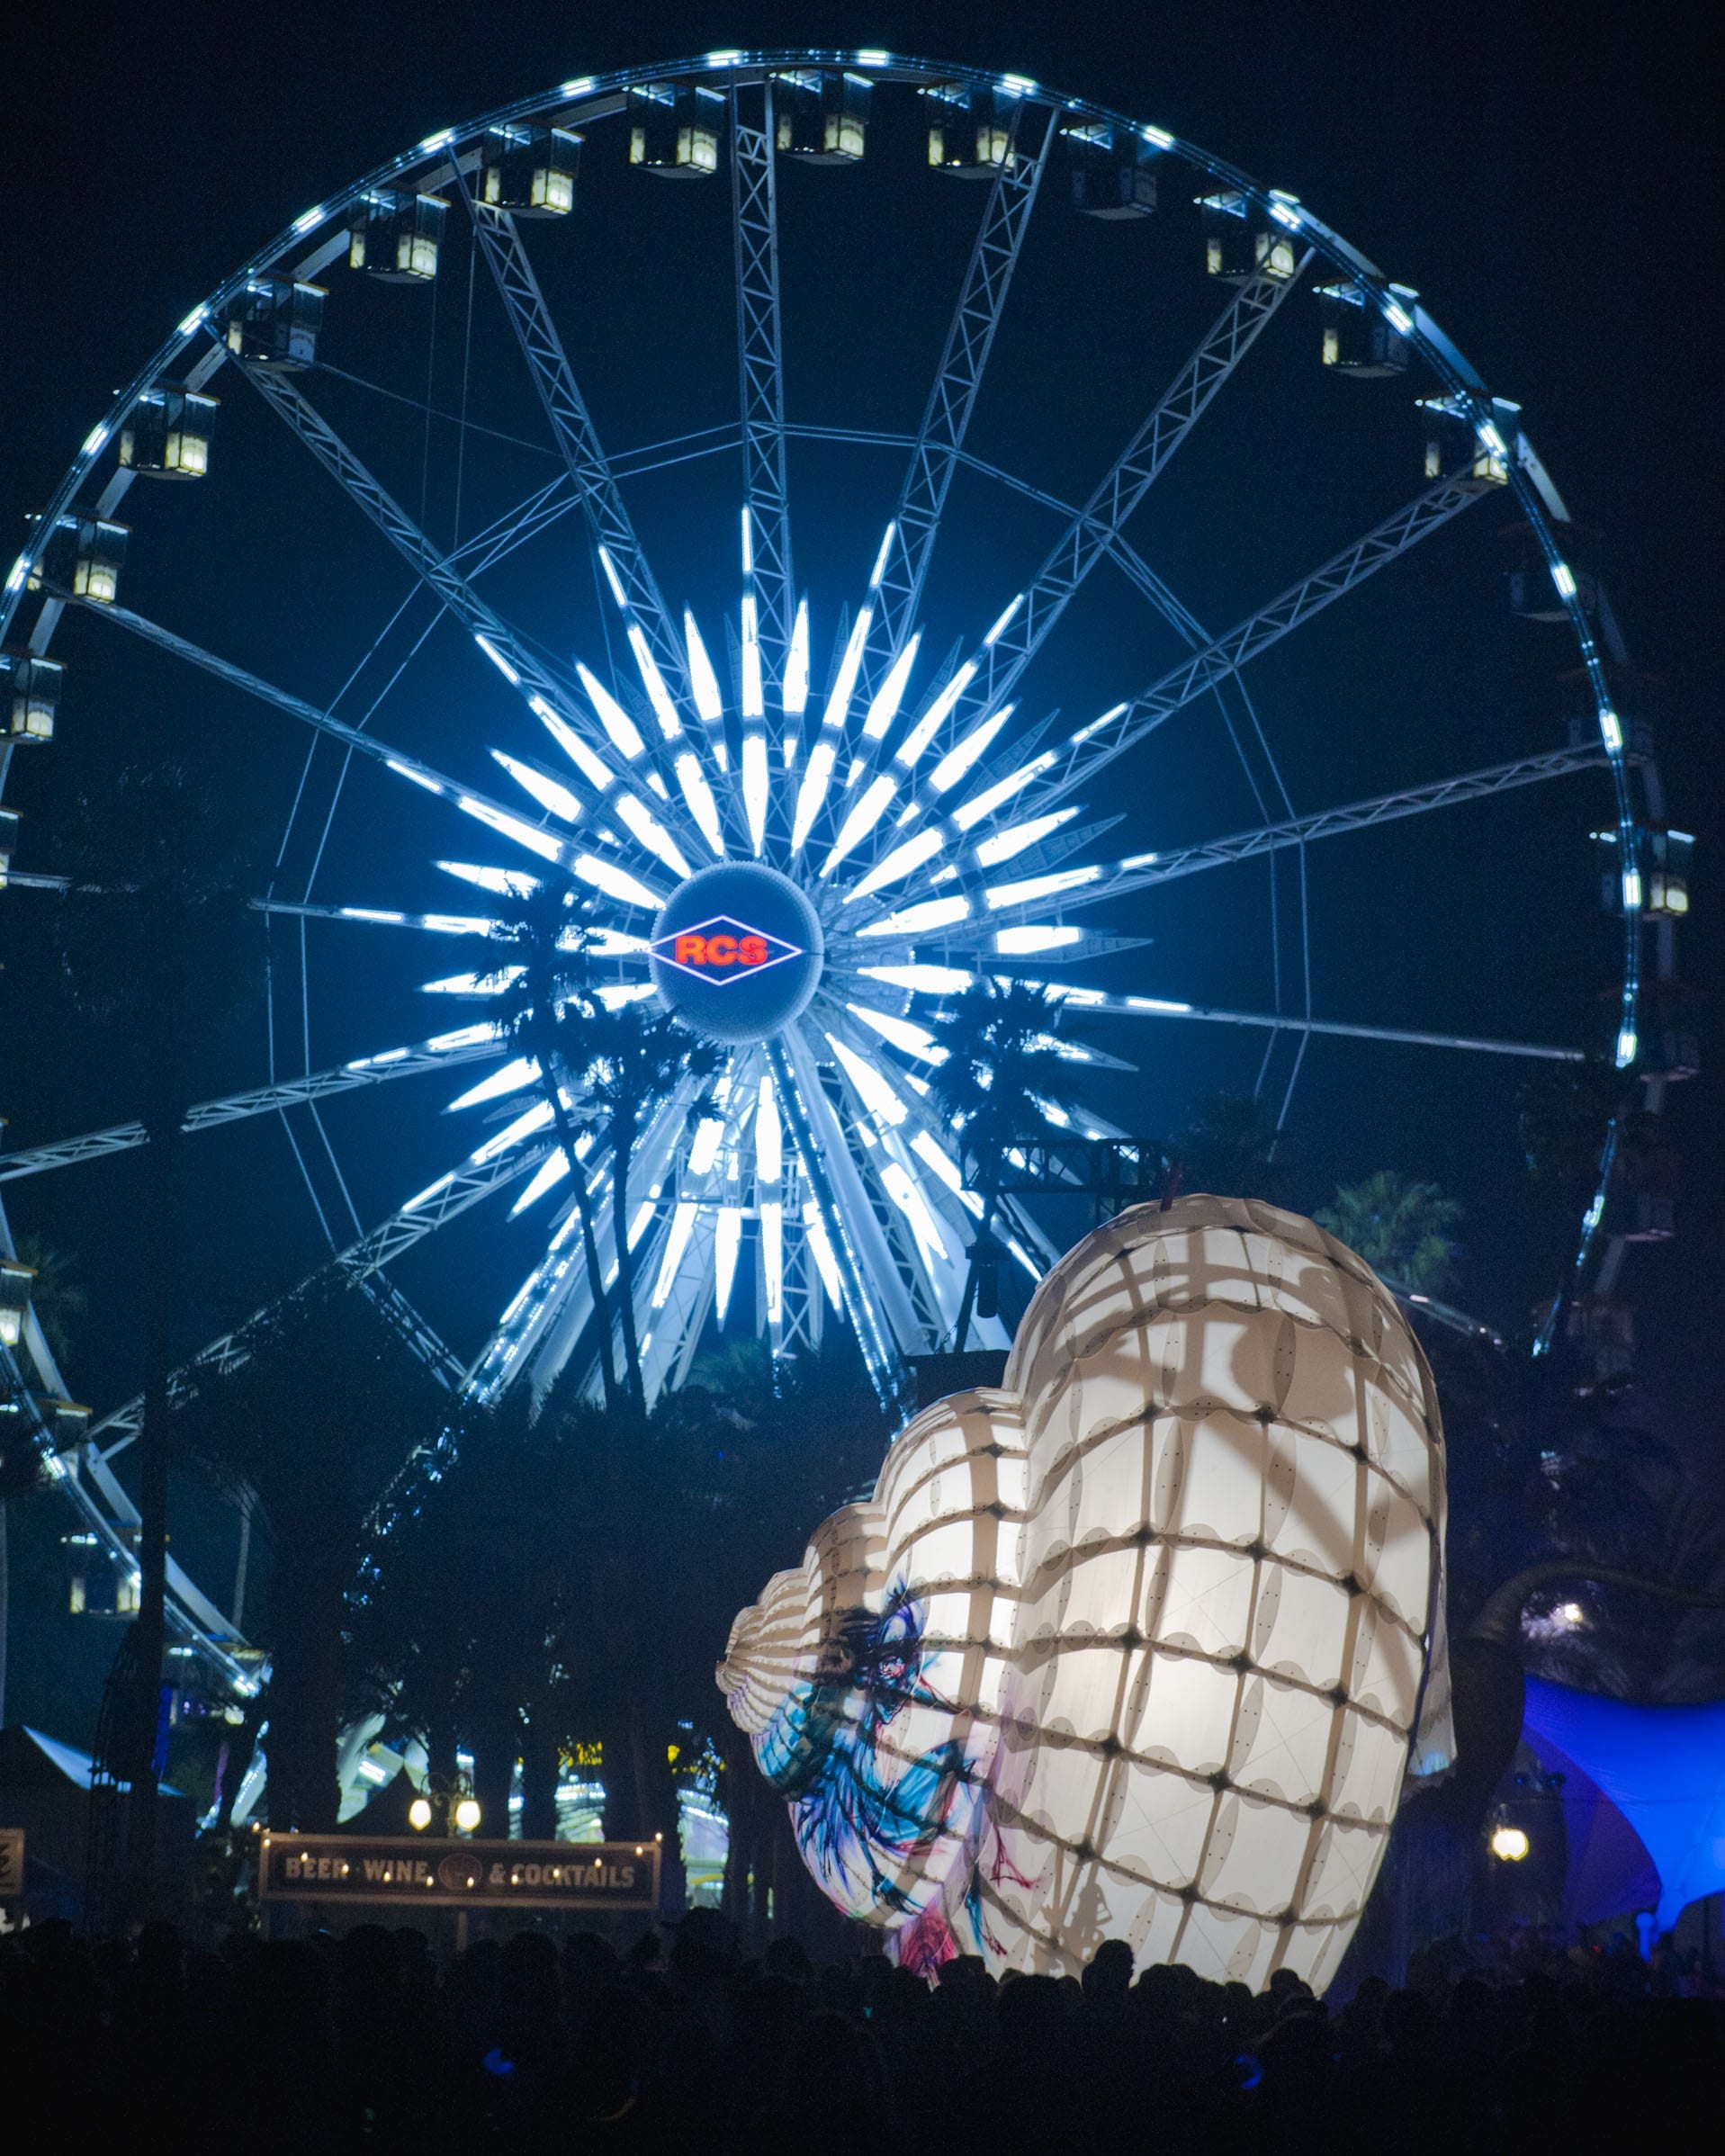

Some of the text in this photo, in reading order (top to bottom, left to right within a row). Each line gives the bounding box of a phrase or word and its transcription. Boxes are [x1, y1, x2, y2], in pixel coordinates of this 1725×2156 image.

[675, 935, 768, 966] RCS
[285, 1856, 348, 1880] BEER
[510, 1863, 635, 1888] COCKTAILS
